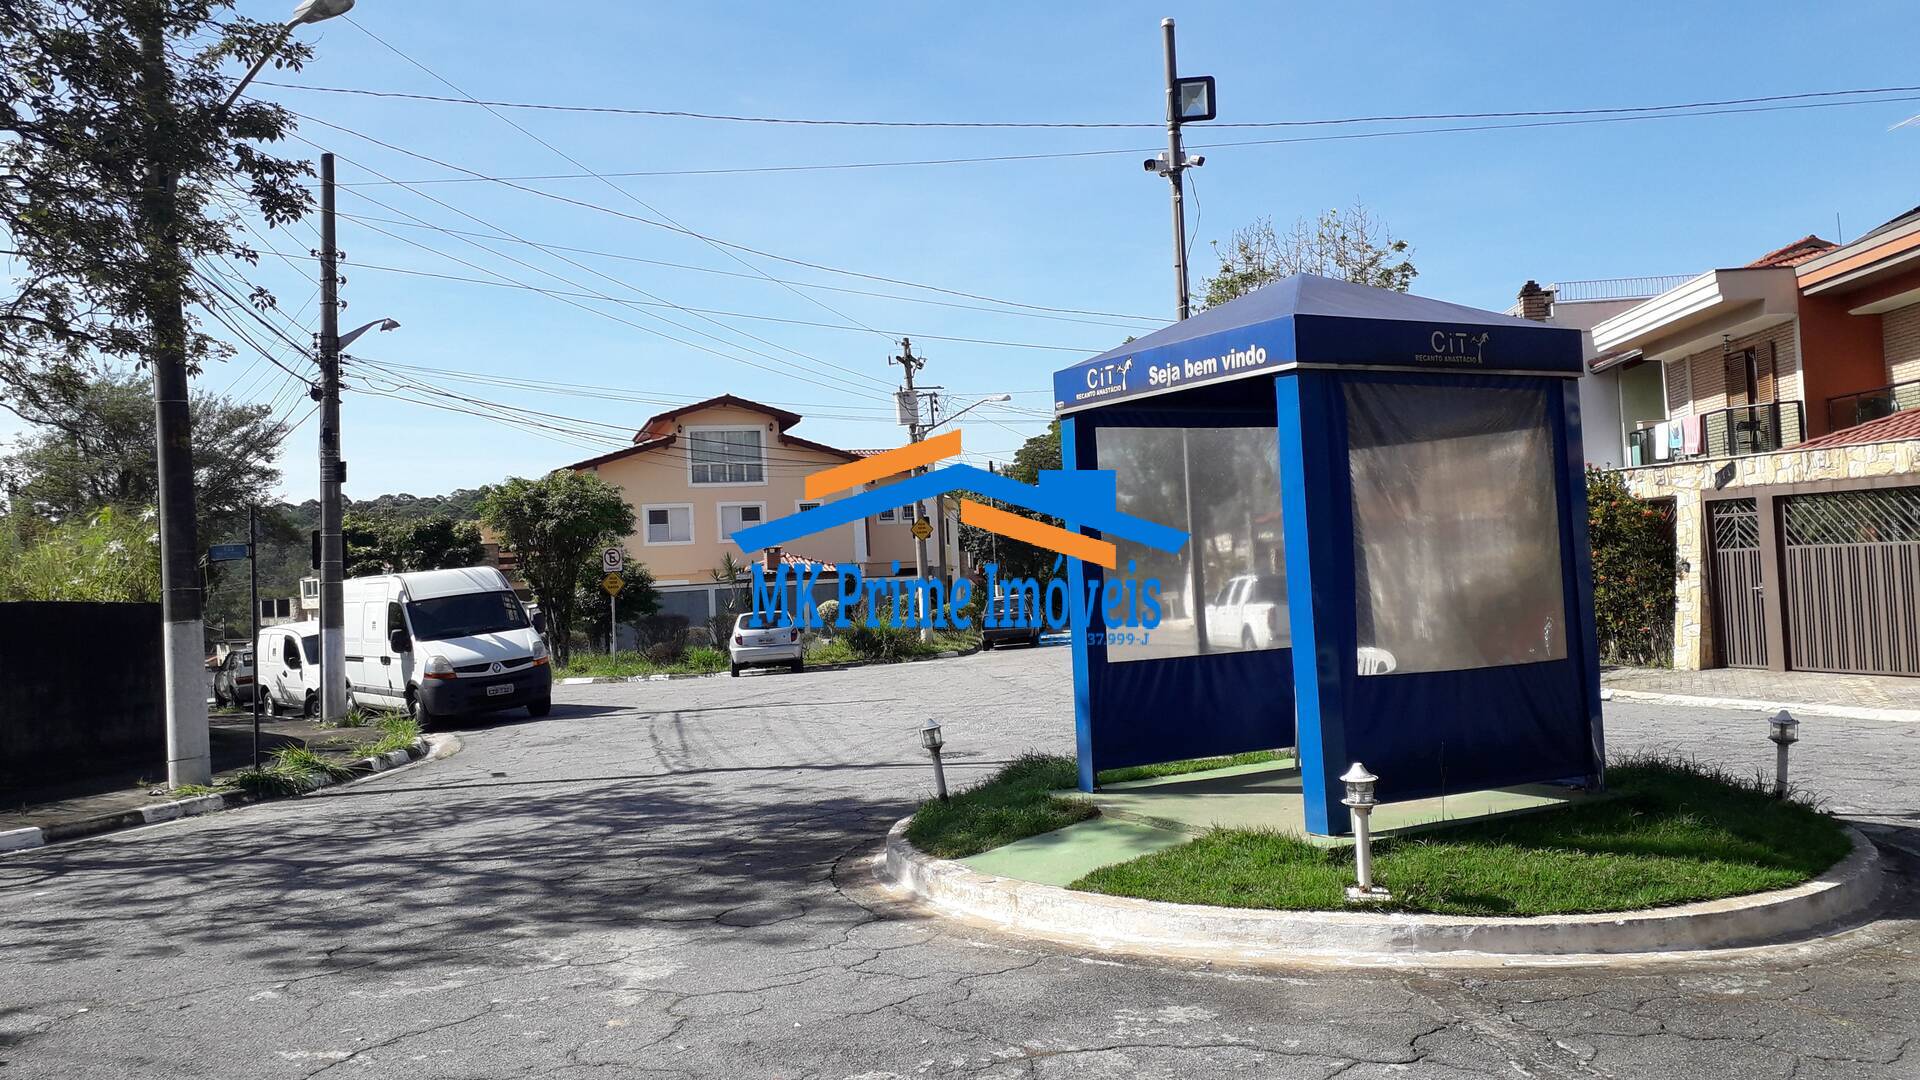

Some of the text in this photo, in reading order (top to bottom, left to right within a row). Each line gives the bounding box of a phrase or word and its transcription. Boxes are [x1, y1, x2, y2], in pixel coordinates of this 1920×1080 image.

[1415, 354, 1443, 362] RECANTO
[1148, 344, 1266, 387] Seja bem vindo
[1076, 390, 1096, 400] RECANTO
